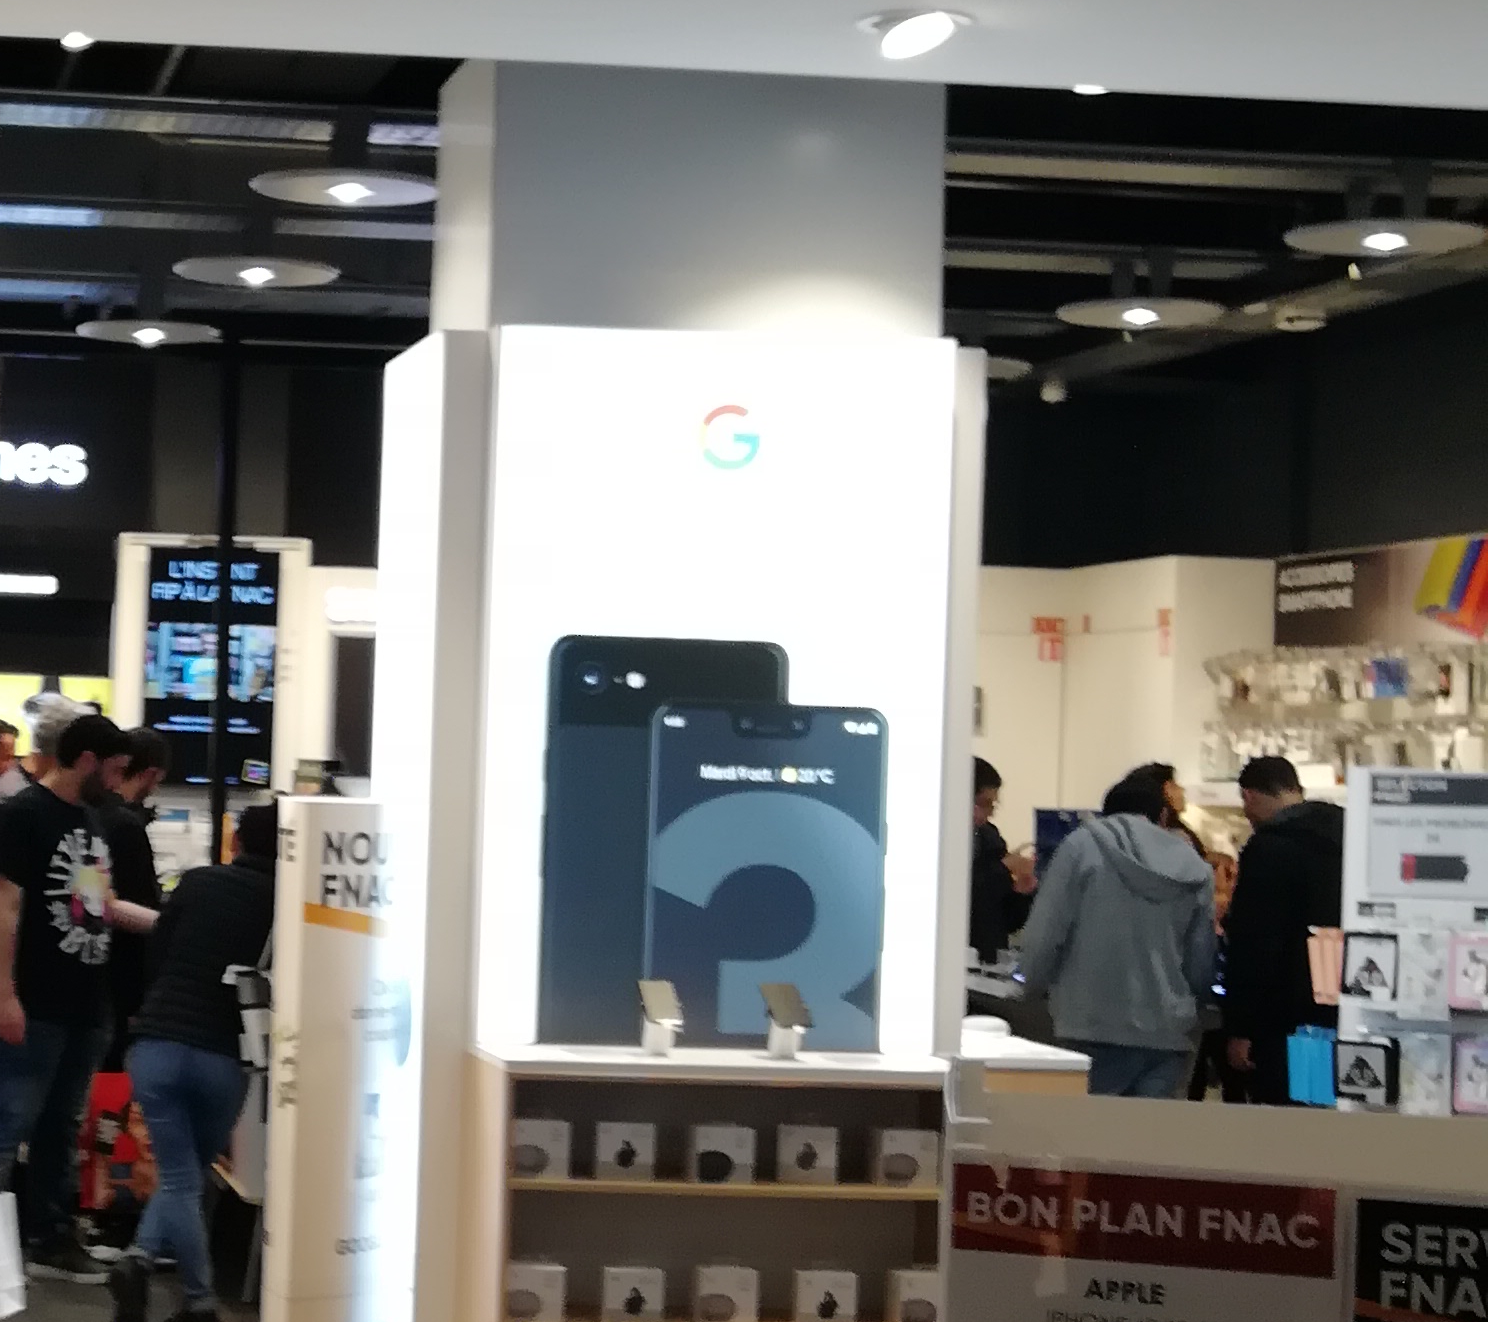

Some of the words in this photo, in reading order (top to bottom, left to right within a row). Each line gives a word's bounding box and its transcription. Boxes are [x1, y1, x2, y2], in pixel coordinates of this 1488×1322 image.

[966, 1189, 1061, 1229] BON
[1071, 1199, 1185, 1239] PLAN
[1197, 1207, 1321, 1250] FNAC
[1379, 1220, 1488, 1271] SER
[1083, 1277, 1167, 1306] APPLE
